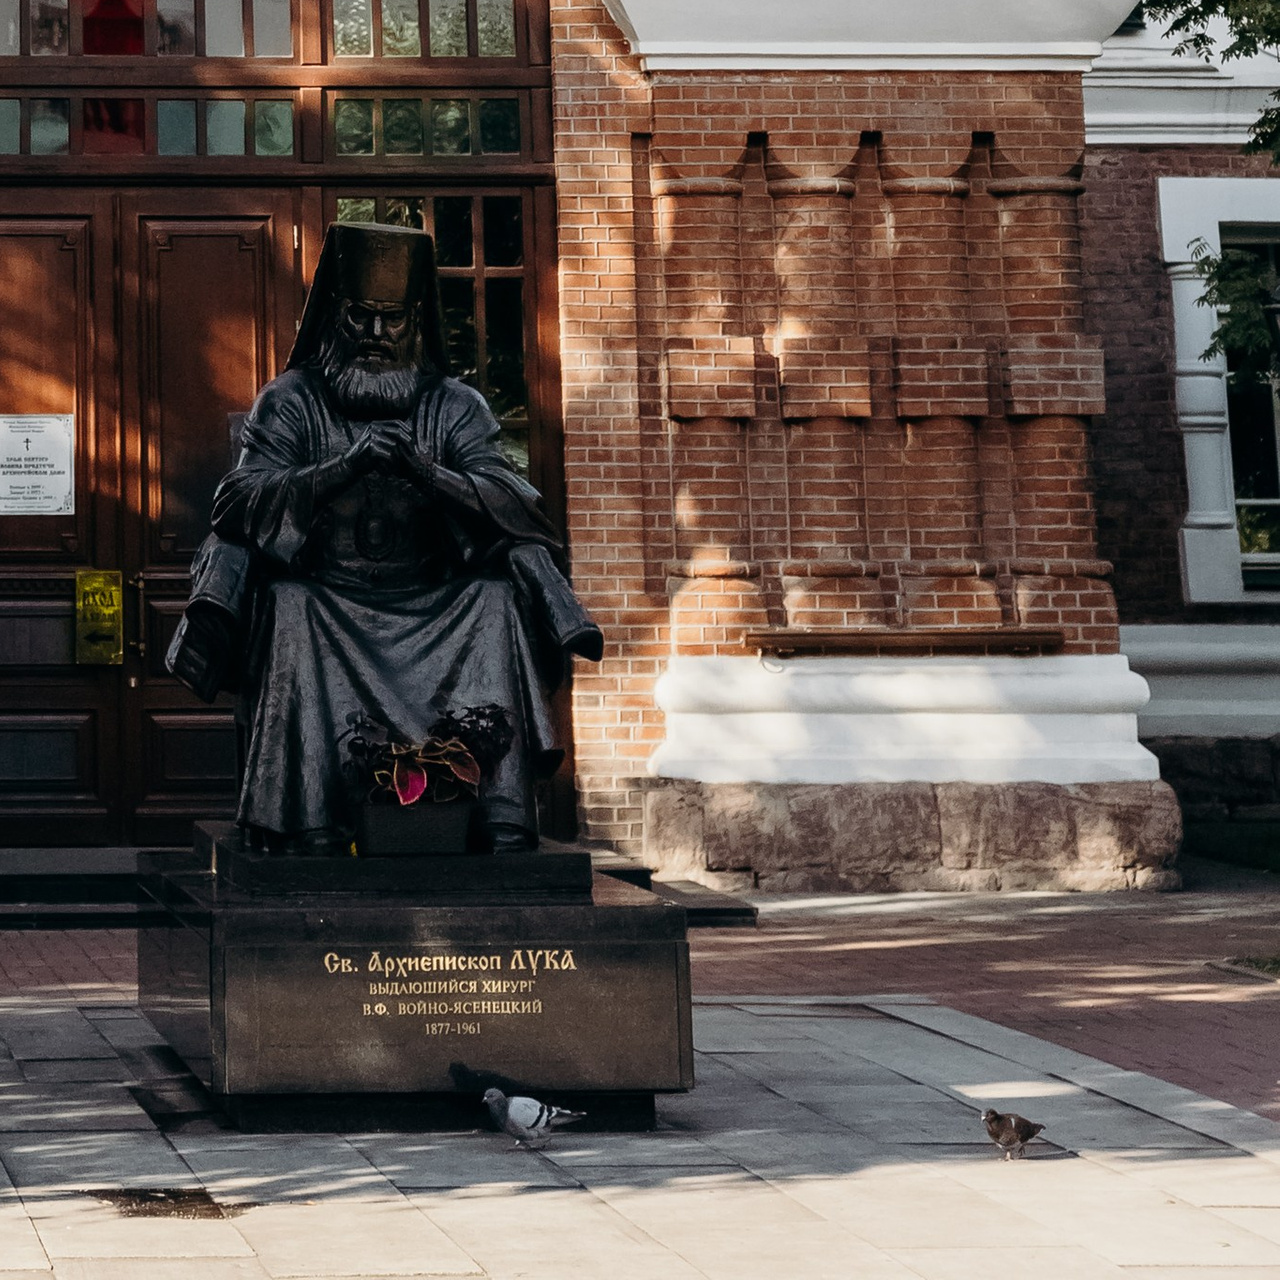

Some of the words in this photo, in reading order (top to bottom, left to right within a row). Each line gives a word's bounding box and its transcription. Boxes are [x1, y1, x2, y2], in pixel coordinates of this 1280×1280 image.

[324, 952, 359, 974] Св.
[368, 951, 502, 978] Архиепископ
[510, 949, 578, 976] ЛУКА
[481, 980, 536, 994] ХИРУРГ
[363, 1002, 391, 1017] В.Ф.
[398, 999, 543, 1016] ВОЙНО-ЯСЕНЕЦКИЙ
[425, 1022, 482, 1035] 1877-1961
